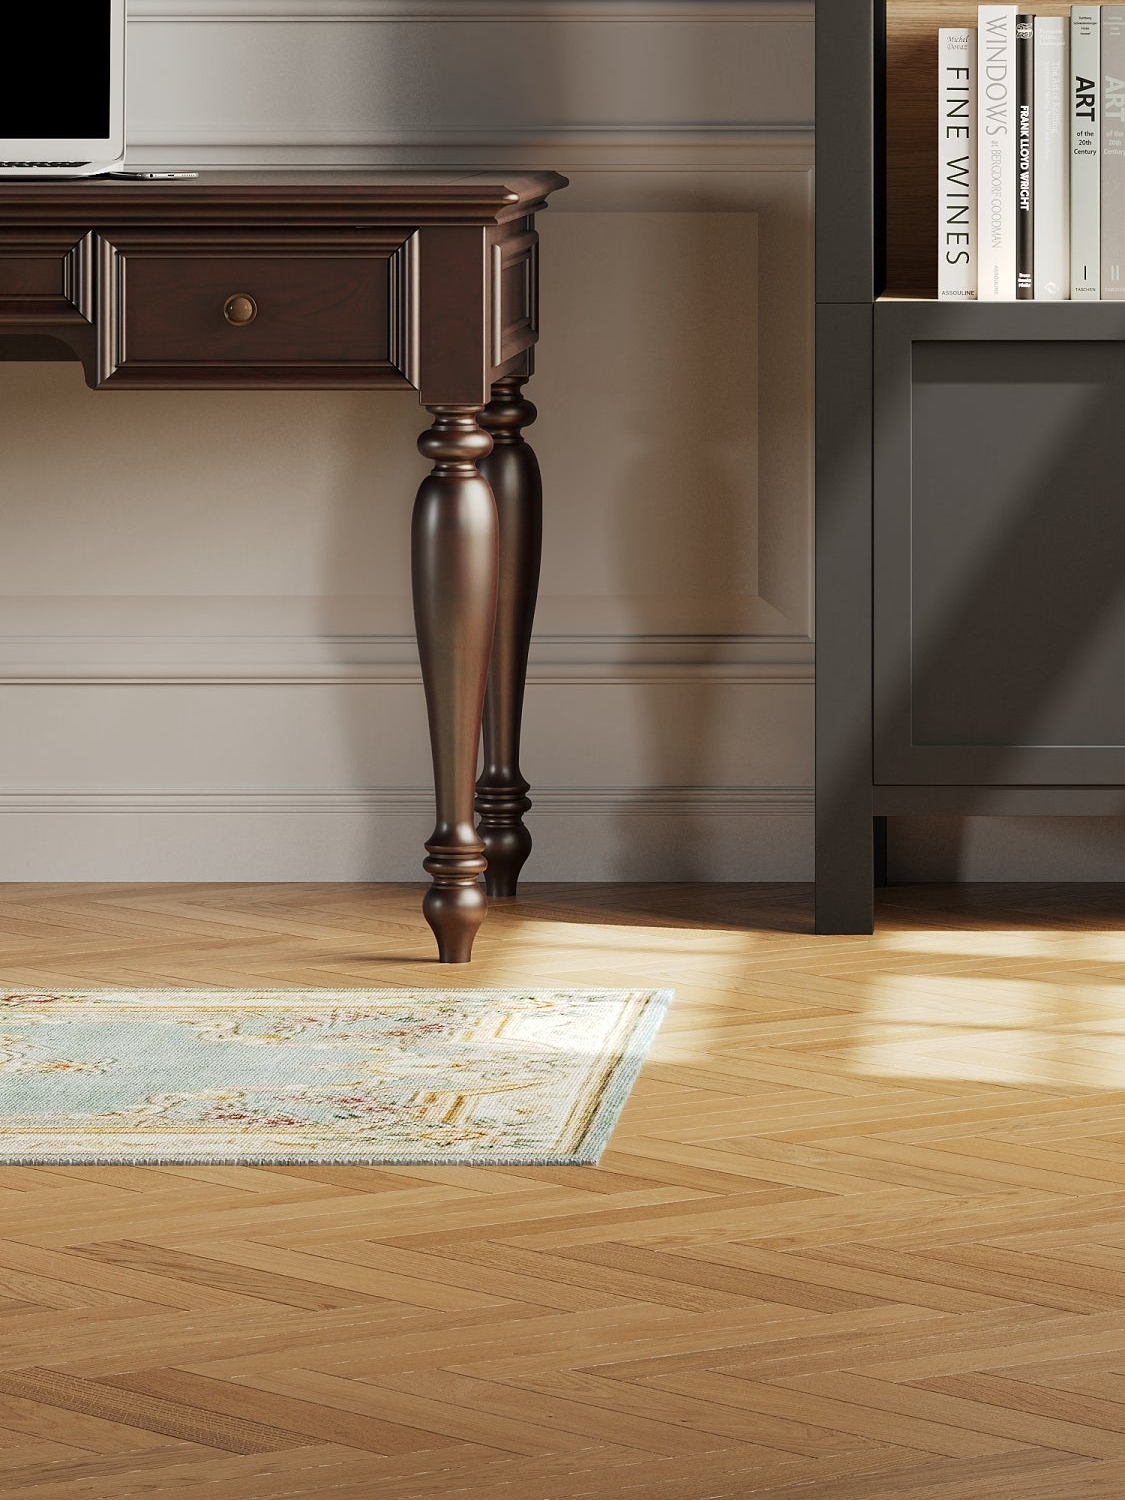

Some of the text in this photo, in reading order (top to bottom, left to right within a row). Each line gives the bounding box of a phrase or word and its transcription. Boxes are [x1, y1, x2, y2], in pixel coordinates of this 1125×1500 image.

[985, 15, 1007, 248] WINDOWS at BERGDORF GOODMAN
[1075, 76, 1095, 122] ART
[1105, 75, 1125, 122] ART
[946, 67, 970, 265] FINE WINES
[1020, 105, 1030, 211] FRANK LLOYD WRIGHT
[1073, 148, 1097, 156] Century
